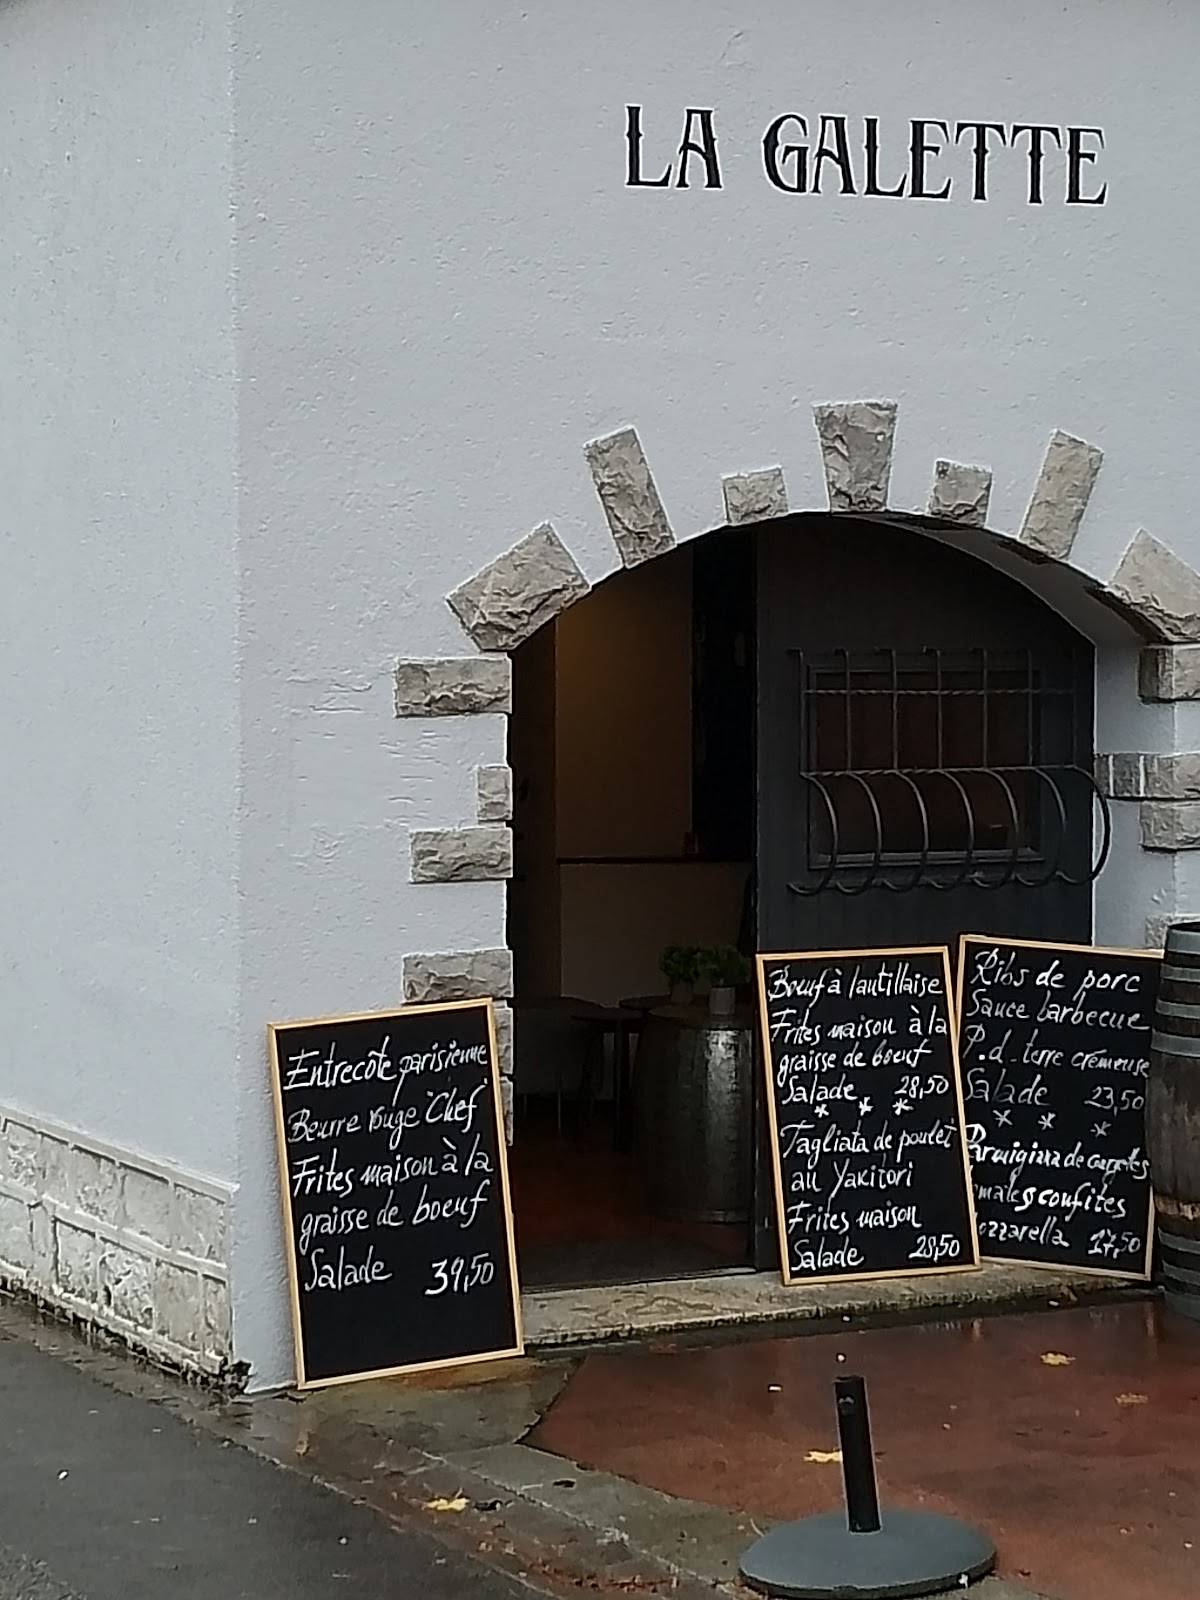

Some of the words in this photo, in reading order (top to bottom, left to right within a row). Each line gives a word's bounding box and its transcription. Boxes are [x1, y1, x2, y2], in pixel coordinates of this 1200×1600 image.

[625, 105, 723, 190] LA
[761, 112, 1107, 205] GALETTE
[828, 968, 842, 994] à
[970, 948, 1030, 987] Ribs
[1036, 960, 1066, 988] de
[1072, 970, 1141, 1001] porc
[770, 1007, 821, 1046] Frites
[827, 1015, 897, 1040] maison
[909, 1004, 923, 1035] à
[929, 1005, 947, 1035] la
[966, 989, 1030, 1018] Sauce
[1037, 990, 1150, 1030] barbecue
[283, 1036, 397, 1090] Entrecôte
[392, 1040, 488, 1106] parisienne
[777, 1050, 836, 1087] graisse
[843, 1041, 866, 1067] de
[782, 1073, 859, 1104] Salade
[894, 1075, 949, 1099] 28,50
[965, 1068, 1051, 1105] Salade
[1084, 1087, 1145, 1116] 23,50
[287, 1108, 361, 1143] Beurre
[369, 1106, 420, 1150] rouge
[780, 1120, 869, 1169] Tagliata
[874, 1120, 892, 1150] de
[896, 1118, 957, 1162] poulet
[292, 1148, 354, 1198] Frites
[360, 1153, 437, 1187] maison
[441, 1136, 458, 1173] à
[464, 1134, 493, 1176] la
[791, 1171, 822, 1192] au
[828, 1154, 913, 1200] Yakitori
[1064, 1141, 1084, 1168] de
[299, 1204, 369, 1254] graisse
[376, 1190, 403, 1227] de
[412, 1179, 490, 1228] boeuf
[787, 1200, 849, 1235] Frites
[856, 1200, 922, 1228] maison
[976, 1216, 1069, 1247] ozzarella
[1088, 1229, 1141, 1259] 17,50
[304, 1245, 392, 1291] Salade
[424, 1252, 494, 1295] 39,50
[791, 1235, 865, 1271] Salade
[909, 1234, 960, 1263] 28,50
